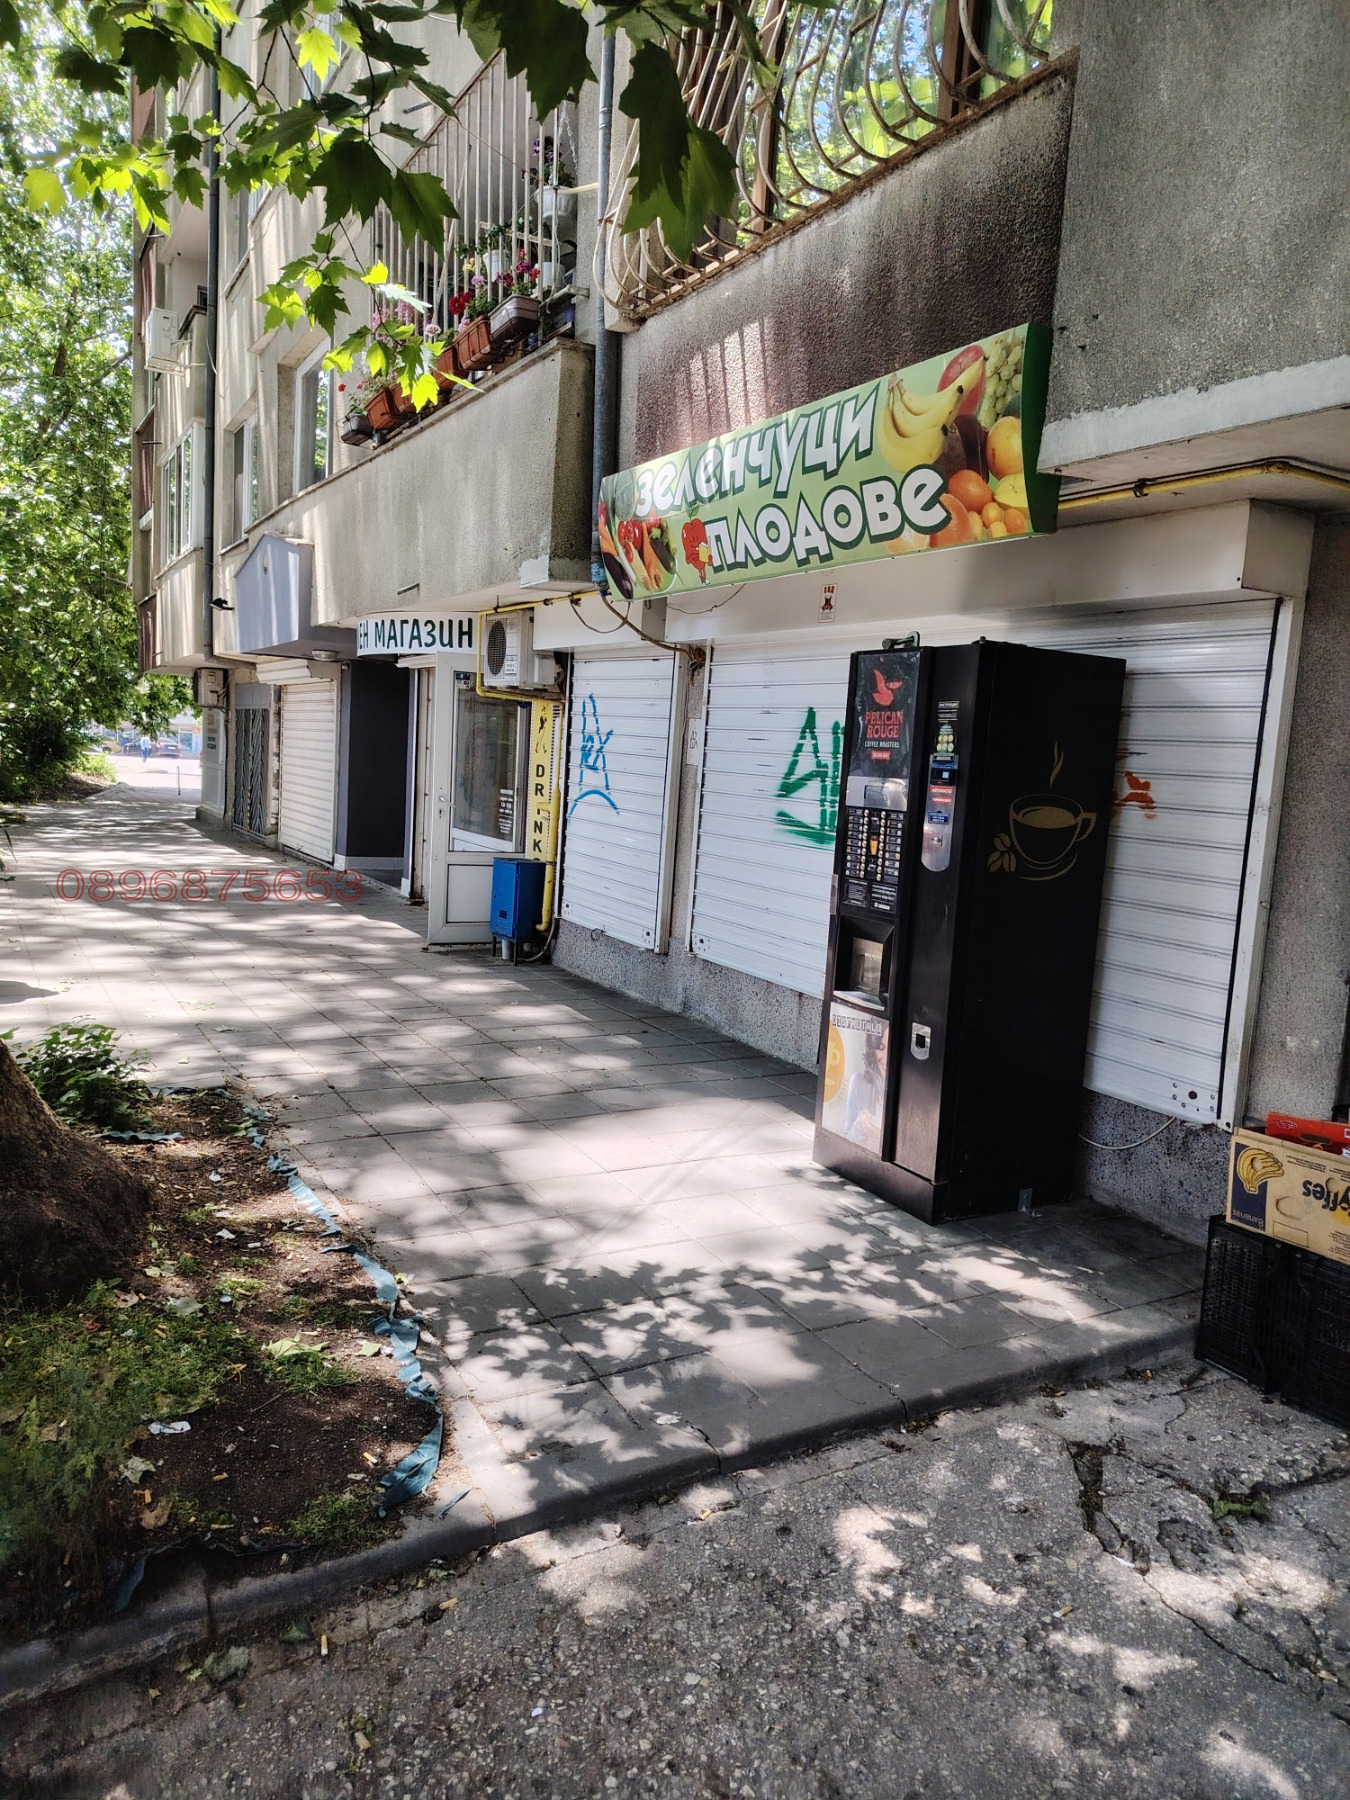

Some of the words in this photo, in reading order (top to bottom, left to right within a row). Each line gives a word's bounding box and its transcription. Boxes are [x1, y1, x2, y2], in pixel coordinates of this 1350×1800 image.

[375, 617, 473, 649] МАГАЗИН
[865, 711, 904, 725] PELICAN
[866, 725, 899, 738] ROUGE
[1232, 1209, 1264, 1228] Bananas
